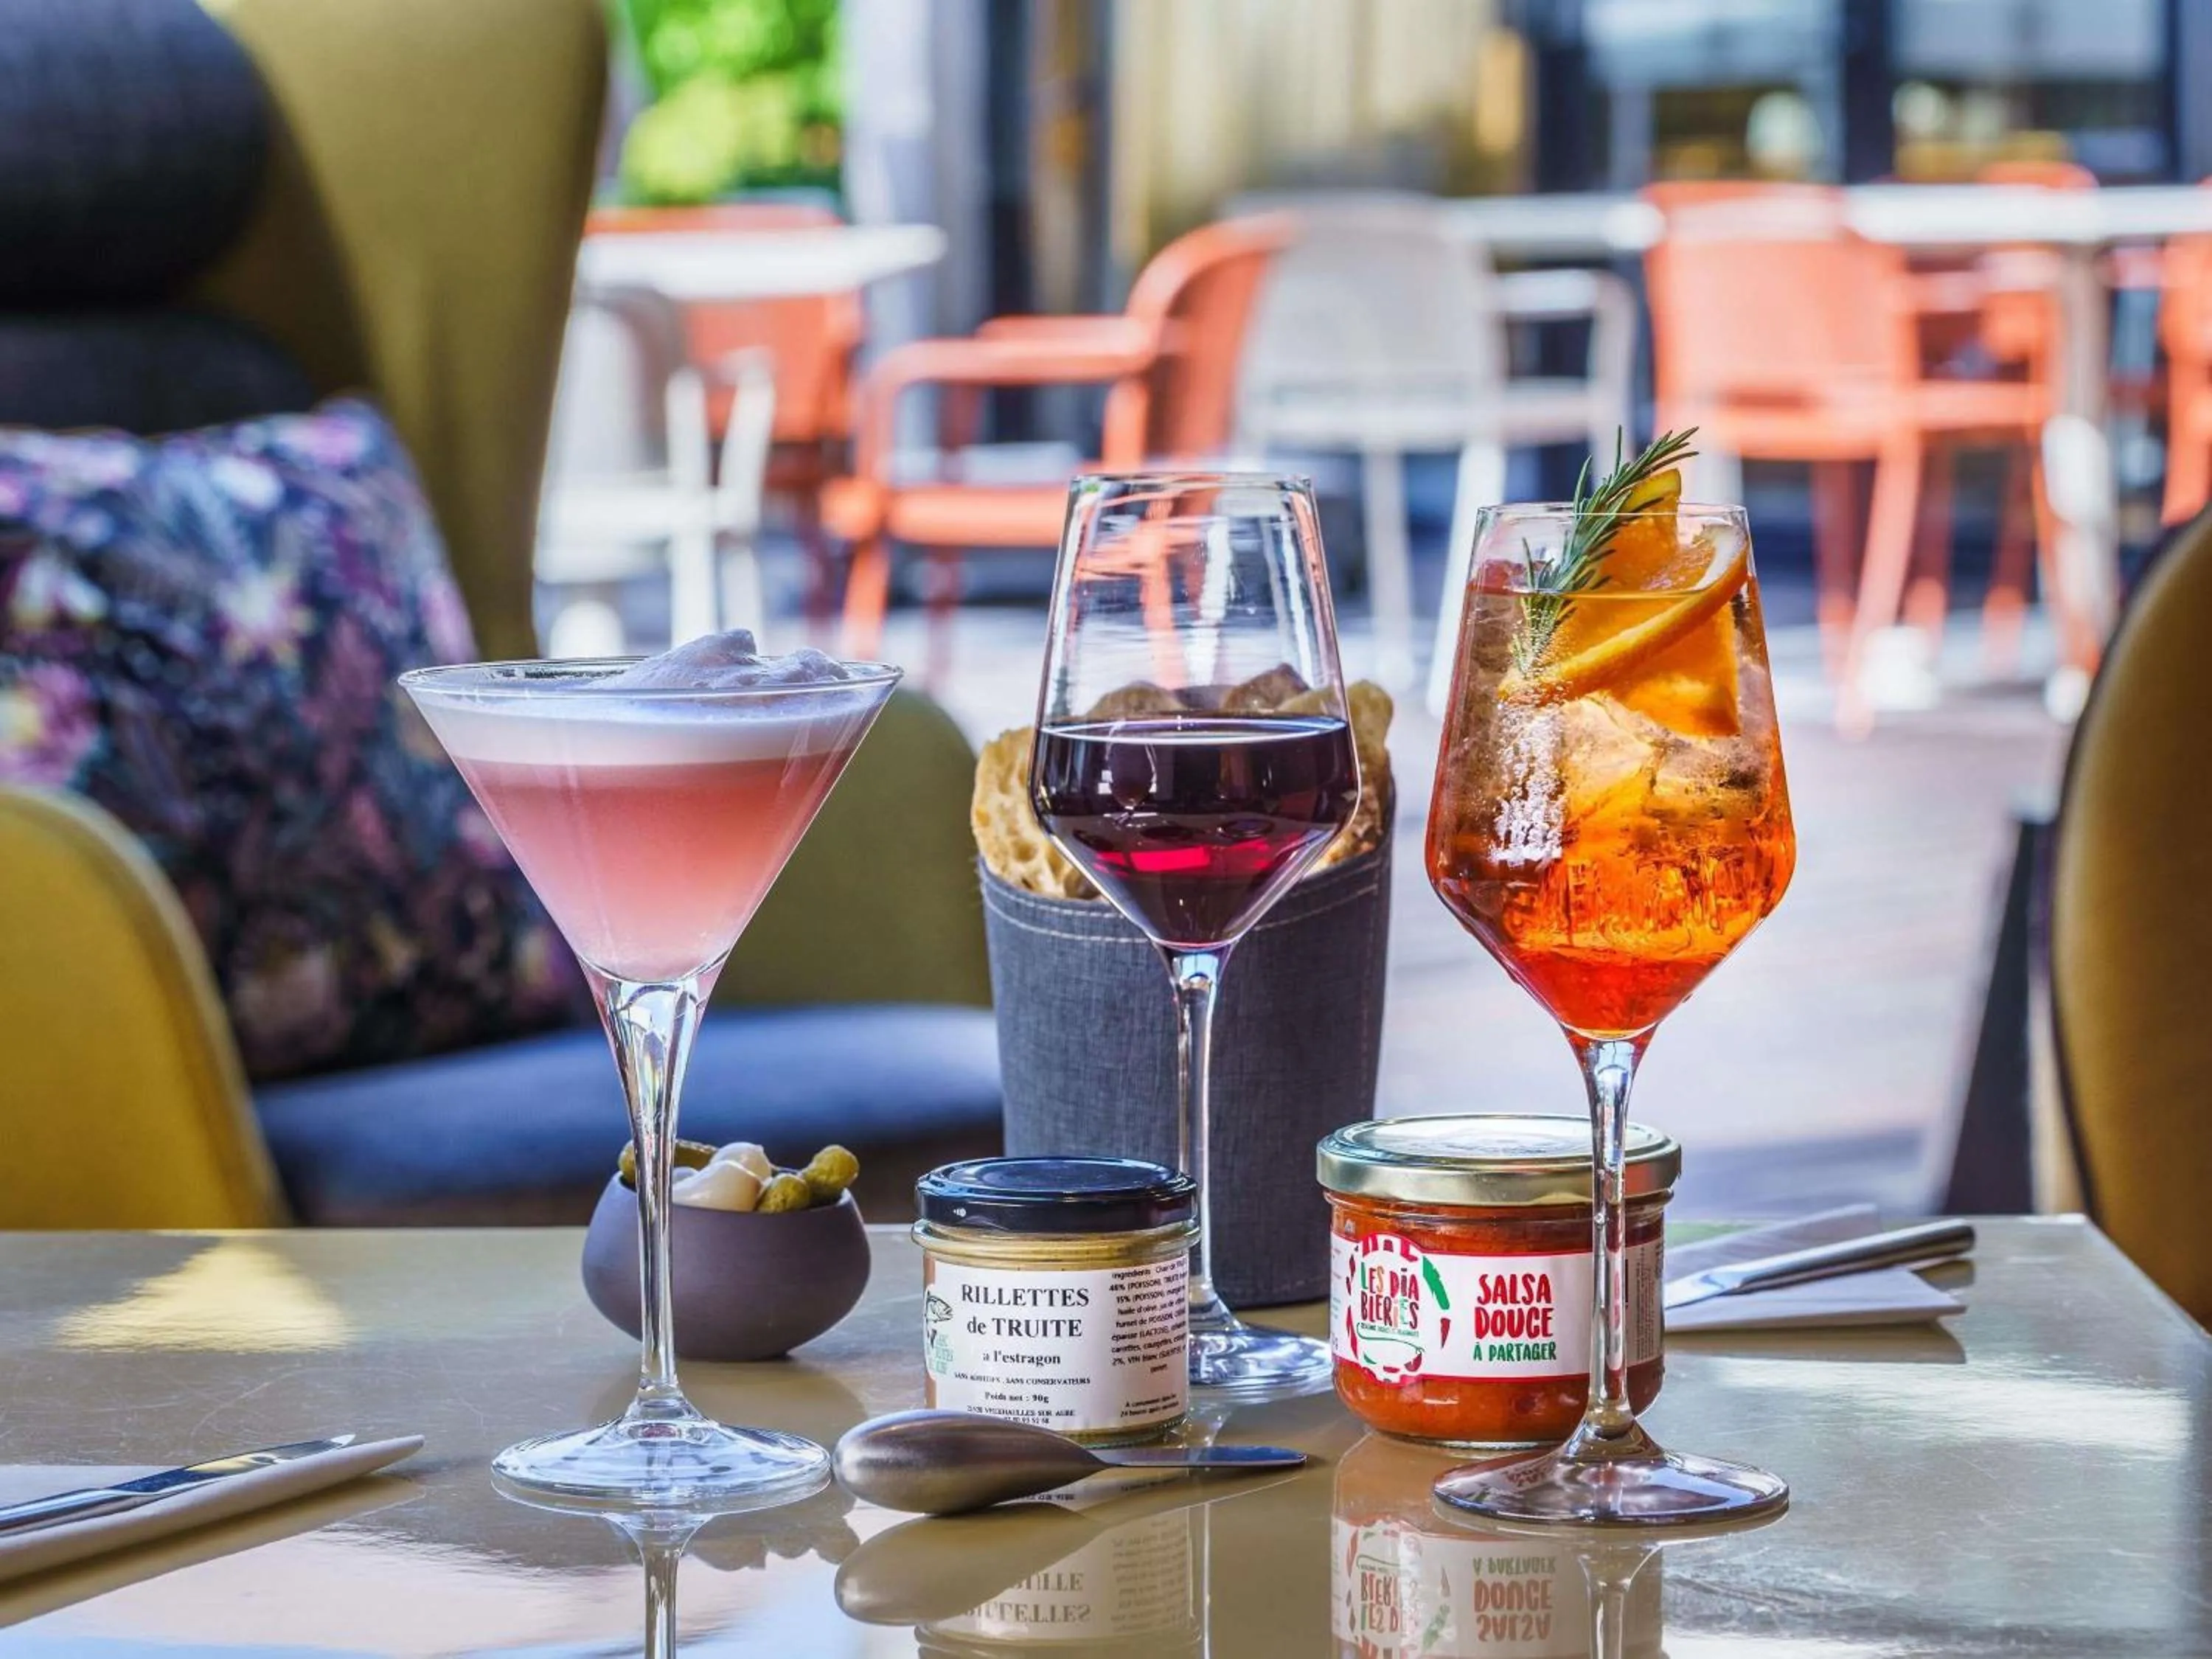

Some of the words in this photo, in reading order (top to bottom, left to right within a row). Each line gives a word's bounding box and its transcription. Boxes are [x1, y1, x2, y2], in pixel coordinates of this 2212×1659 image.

[1361, 1262, 1385, 1293] LES
[961, 1284, 1090, 1307] RILLETTES
[1477, 1273, 1552, 1305] SALSA
[967, 1315, 987, 1335] de
[992, 1318, 1082, 1337] TRUITE
[1475, 1307, 1554, 1339] DOUCE
[994, 1350, 1061, 1367] l'estragon
[1473, 1342, 1482, 1361] À
[1489, 1341, 1557, 1362] PARTAGER
[1026, 1377, 1091, 1385] CONSERVATEURS
[984, 1391, 1006, 1401] Poids
[1032, 1394, 1050, 1404] 90g
